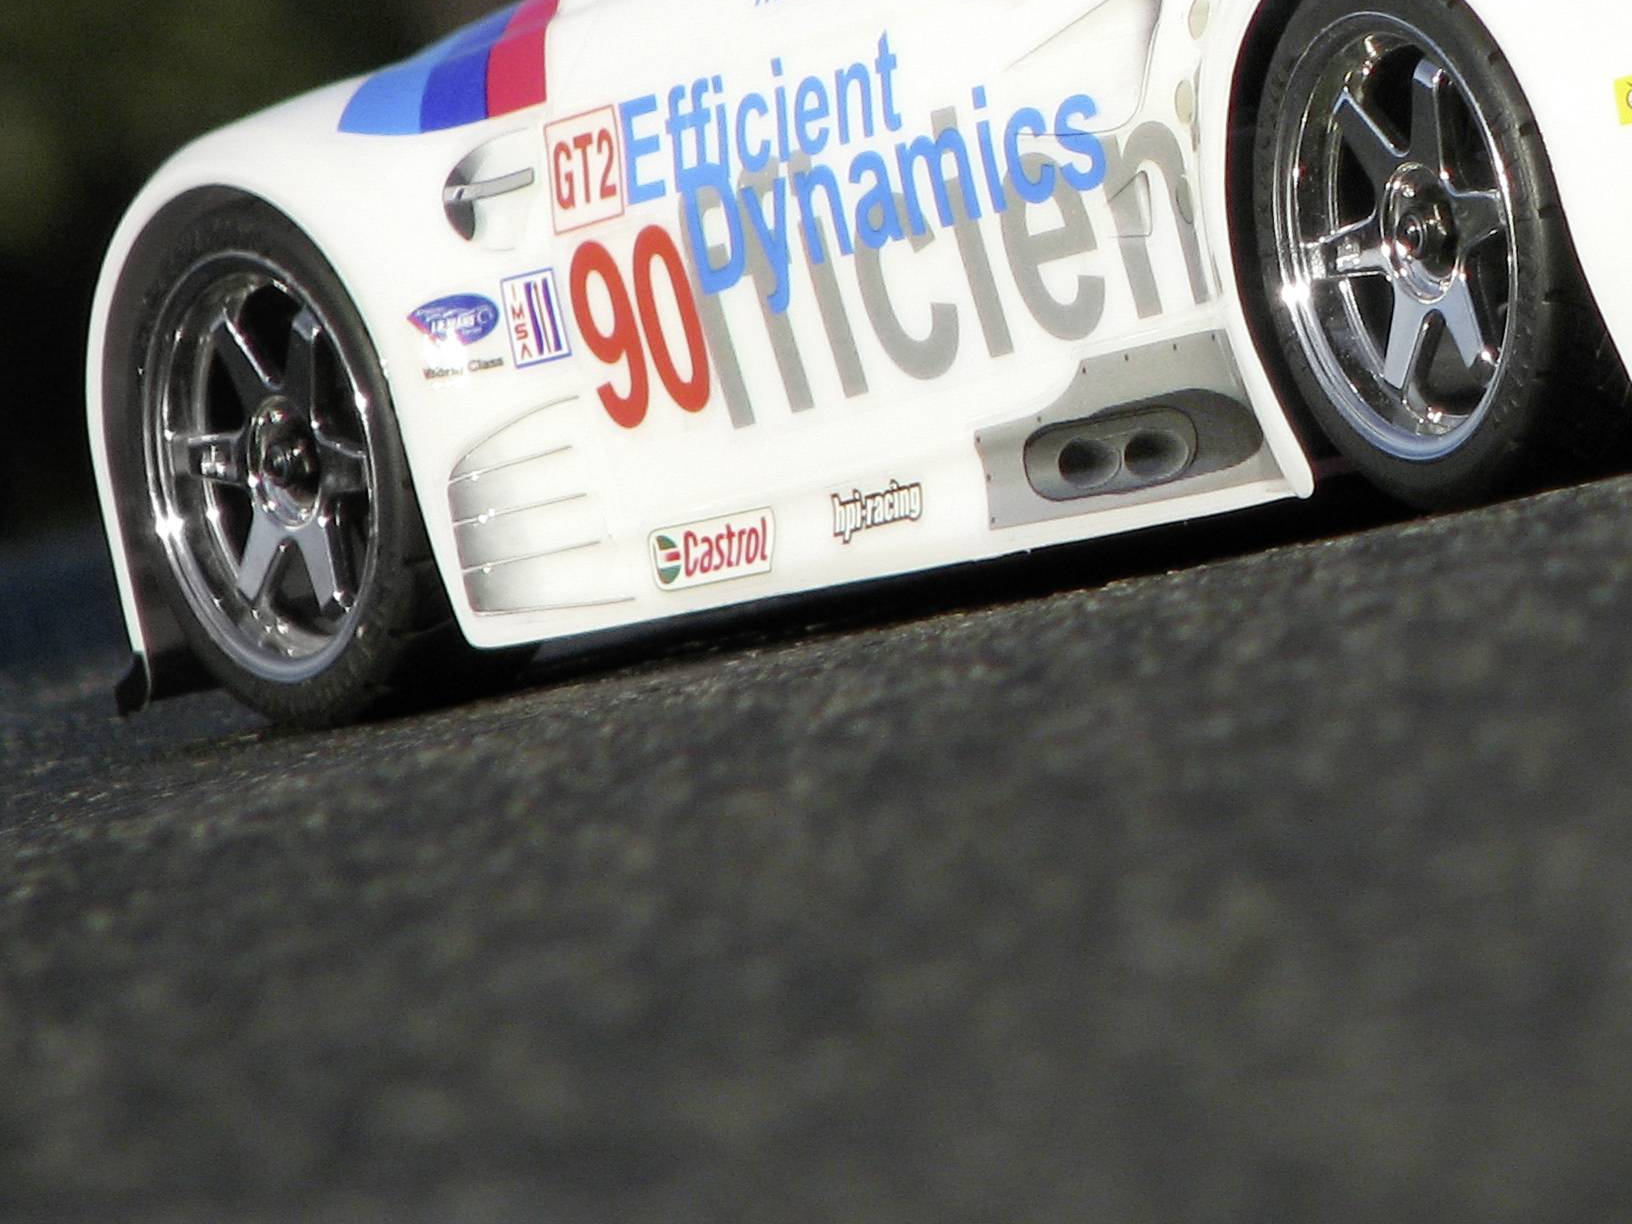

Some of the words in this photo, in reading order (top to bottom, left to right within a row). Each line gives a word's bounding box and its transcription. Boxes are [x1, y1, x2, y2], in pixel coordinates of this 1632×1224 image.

[552, 127, 617, 210] GT2
[618, 29, 903, 206] Efficient
[675, 86, 1106, 315] Dynamics
[569, 224, 711, 429] 90
[683, 516, 768, 577] Castrol
